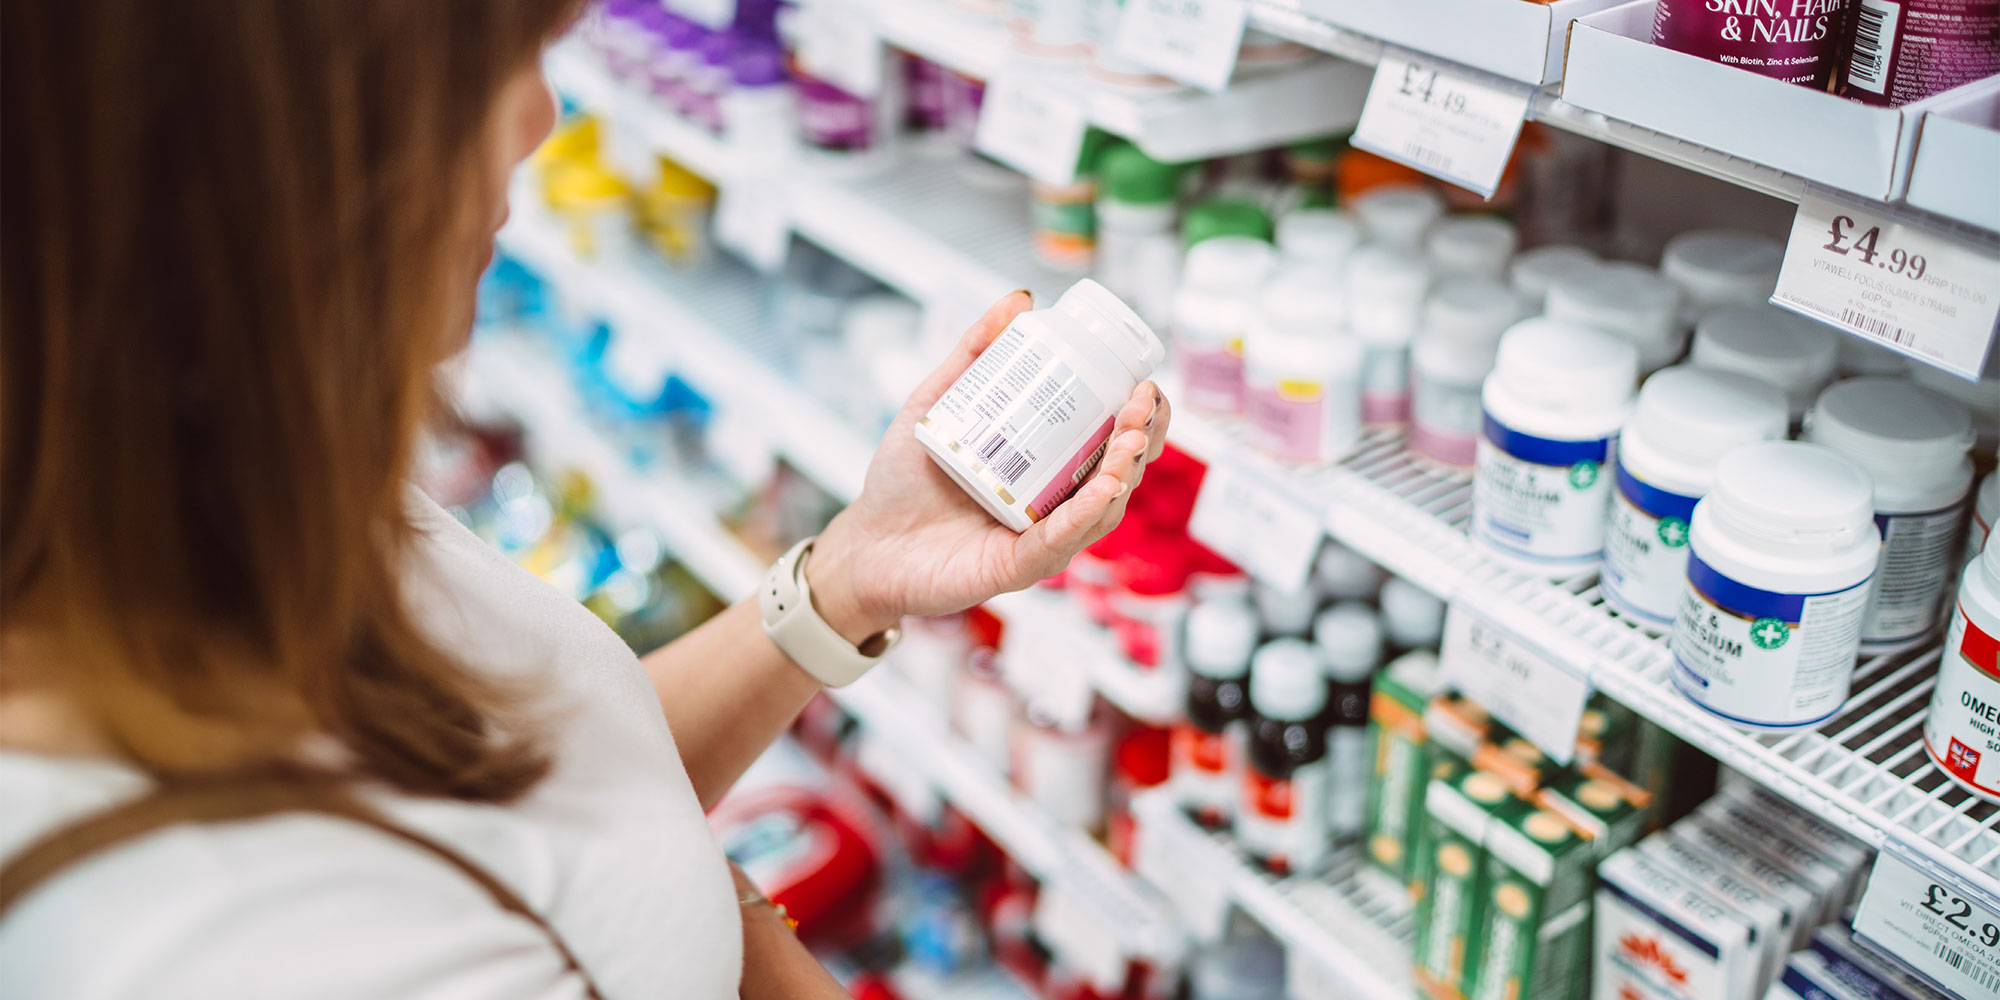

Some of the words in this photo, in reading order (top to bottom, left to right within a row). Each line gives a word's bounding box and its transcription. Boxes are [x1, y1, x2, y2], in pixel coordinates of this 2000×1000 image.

[1721, 16, 1742, 41] &
[1750, 16, 1828, 42] NAILS
[1903, 35, 1936, 43] INGREDIENTS:
[1720, 54, 1738, 64] With
[1740, 57, 1764, 66] Biotin,
[1791, 56, 1818, 65] Selenium
[1823, 215, 1926, 281] £4.99
[1923, 274, 1948, 290] RRP
[1813, 258, 1852, 281] VITAWELL
[1854, 273, 1884, 291] FOCUS
[1885, 284, 1918, 303] GUMMY
[1920, 296, 1957, 318] STRAWB
[1861, 289, 1893, 309] 60Pcs
[1969, 718, 1995, 737] HIGH
[1920, 884, 2000, 948] £2.9
[1952, 932, 1986, 956] OMEGA
